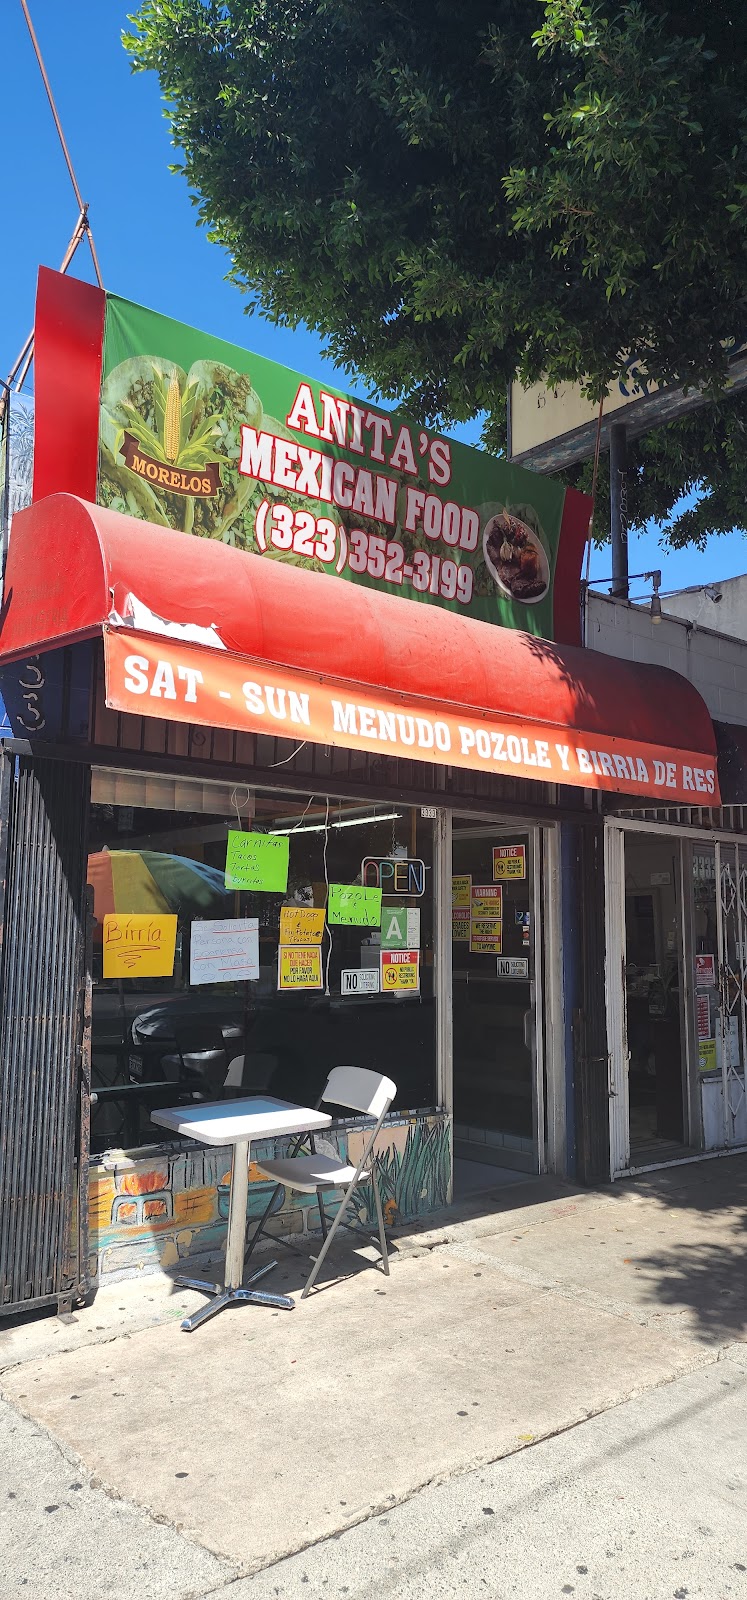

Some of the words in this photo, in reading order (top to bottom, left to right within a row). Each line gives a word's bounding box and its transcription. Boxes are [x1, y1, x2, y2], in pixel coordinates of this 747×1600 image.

[286, 383, 452, 487] ANITA'S
[132, 454, 212, 494] MORELOS
[239, 424, 398, 527] MEXICAN
[405, 486, 480, 551] FOOD
[124, 655, 204, 703] SAT
[242, 681, 310, 725] SUN
[331, 700, 451, 752] MENUDO
[458, 725, 551, 768] POZOLE
[555, 743, 570, 771] Y
[576, 748, 649, 783] BIRRIA
[652, 759, 677, 788] DE
[683, 766, 715, 794] RES
[232, 835, 284, 849] Carnitas
[231, 851, 257, 861] Tacos
[500, 848, 517, 857] NOTICE
[230, 862, 259, 872] Tortas
[364, 862, 422, 892] OPEN
[475, 888, 498, 897] WARNING
[284, 910, 298, 919] Hot
[300, 910, 318, 921] Dogs
[332, 909, 378, 925] Menudo
[106, 919, 166, 943] Birria
[386, 916, 403, 939] A
[193, 934, 234, 945] Persona
[307, 951, 318, 959] NADA
[391, 953, 410, 963] NOTICE
[500, 961, 510, 974] NO
[346, 974, 357, 989] NO
